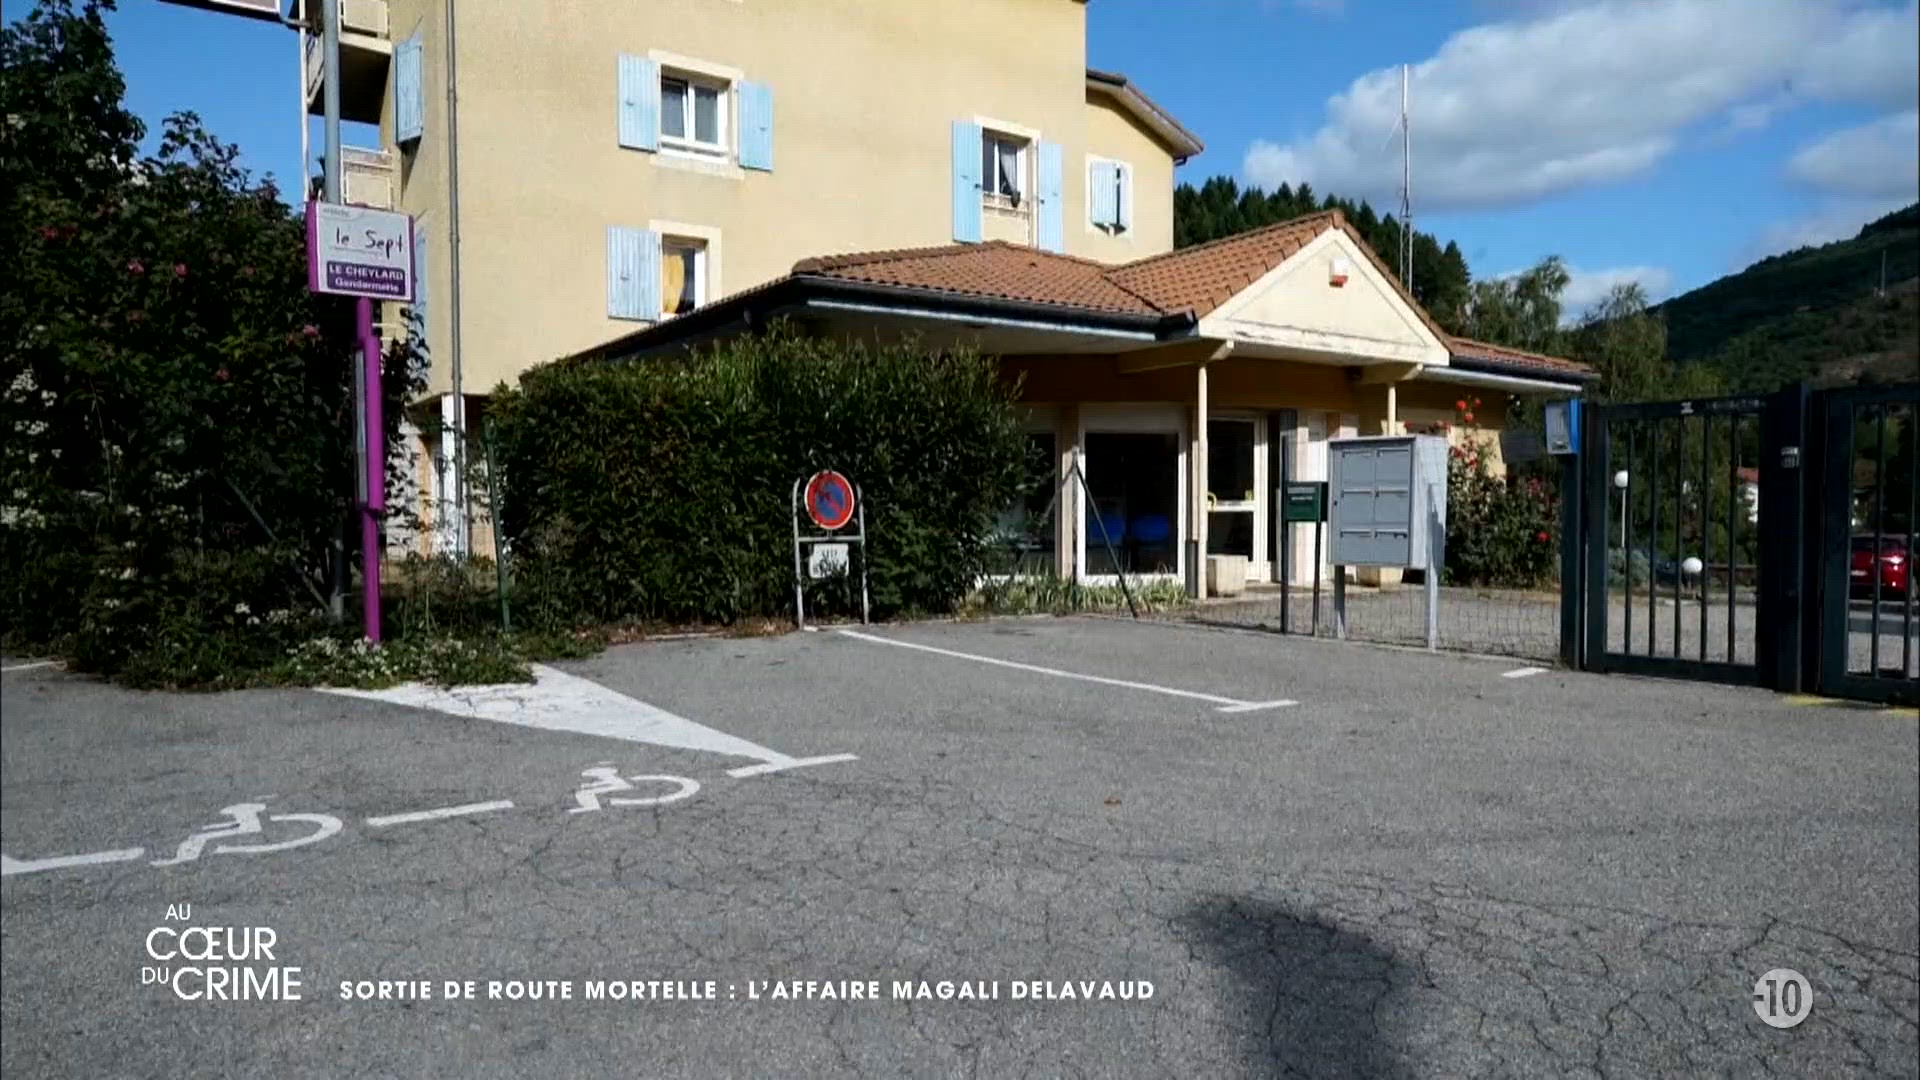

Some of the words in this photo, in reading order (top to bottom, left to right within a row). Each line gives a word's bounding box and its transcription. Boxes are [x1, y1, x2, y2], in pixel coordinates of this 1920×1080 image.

[336, 226, 350, 244] le
[365, 229, 402, 260] Sept
[329, 264, 342, 274] LE
[345, 266, 403, 280] CHEYLARD
[335, 277, 399, 292] Gendarmerie
